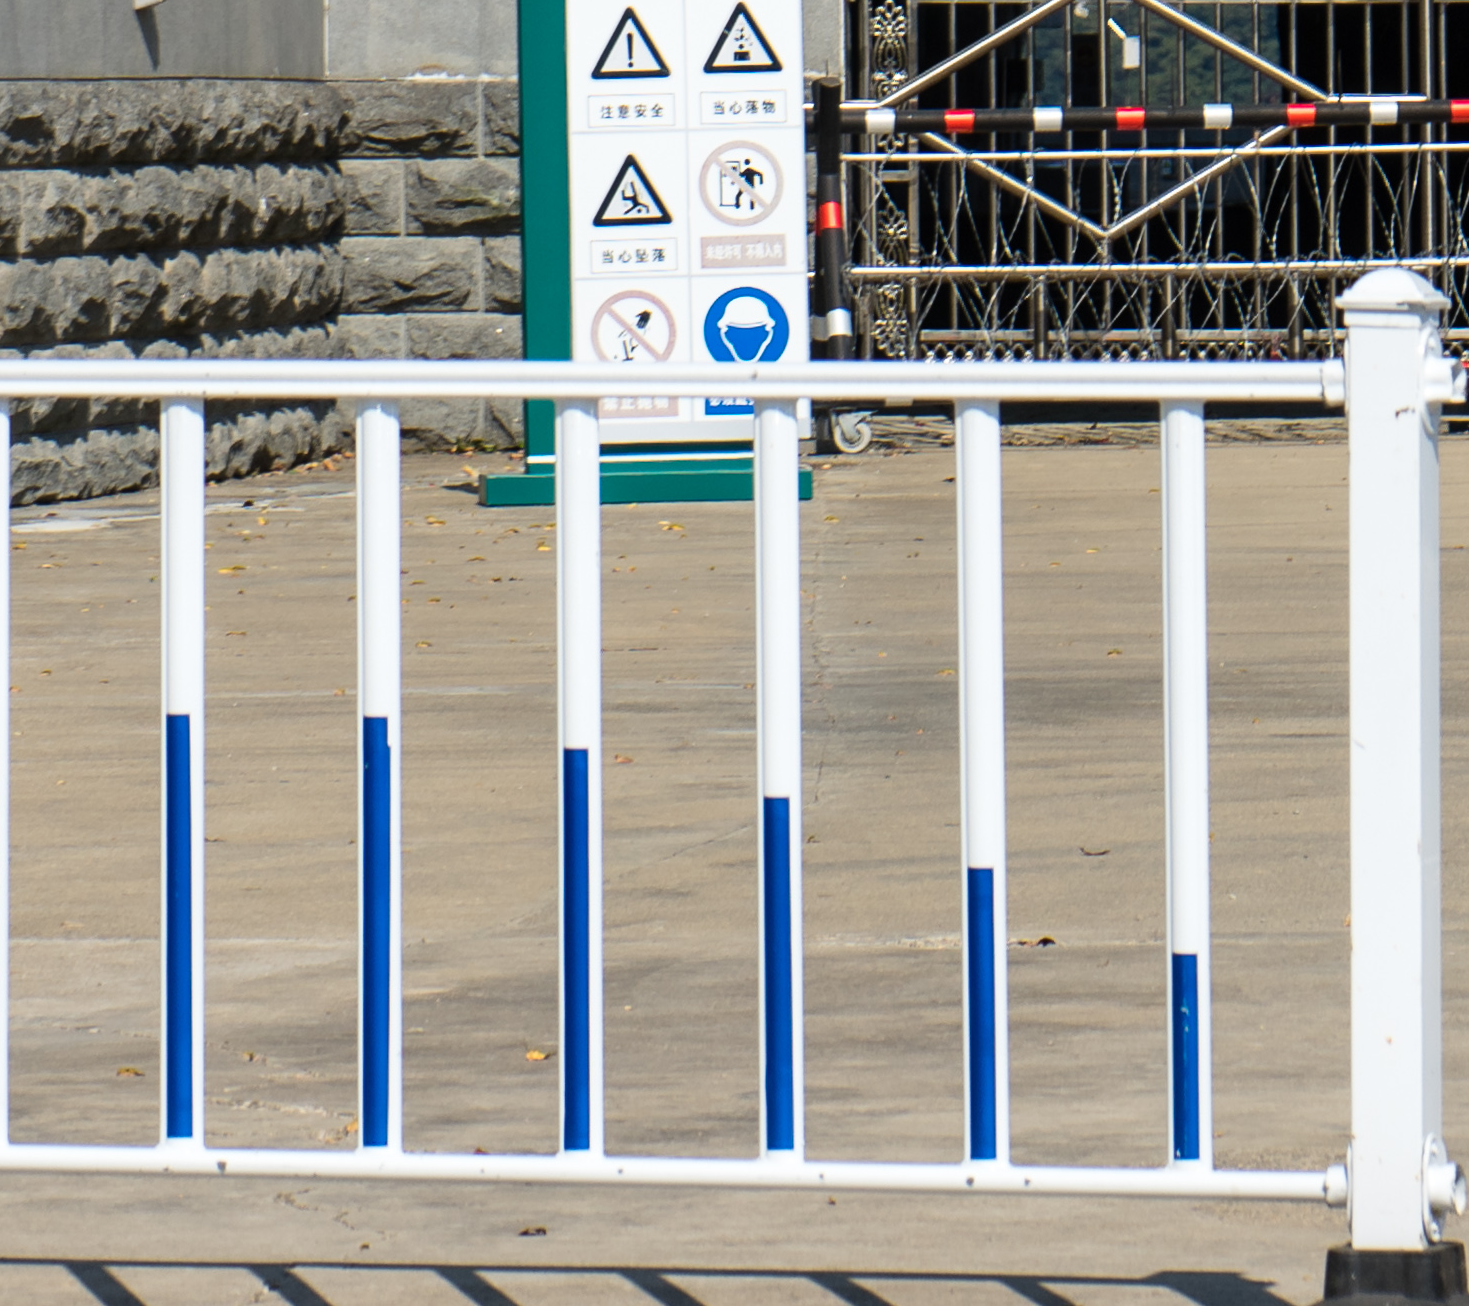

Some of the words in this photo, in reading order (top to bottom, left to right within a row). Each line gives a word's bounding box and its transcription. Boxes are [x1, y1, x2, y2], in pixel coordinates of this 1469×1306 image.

[600, 102, 665, 119] 注意安全
[713, 99, 777, 115] 当心落物
[601, 248, 666, 264] 当心坠落
